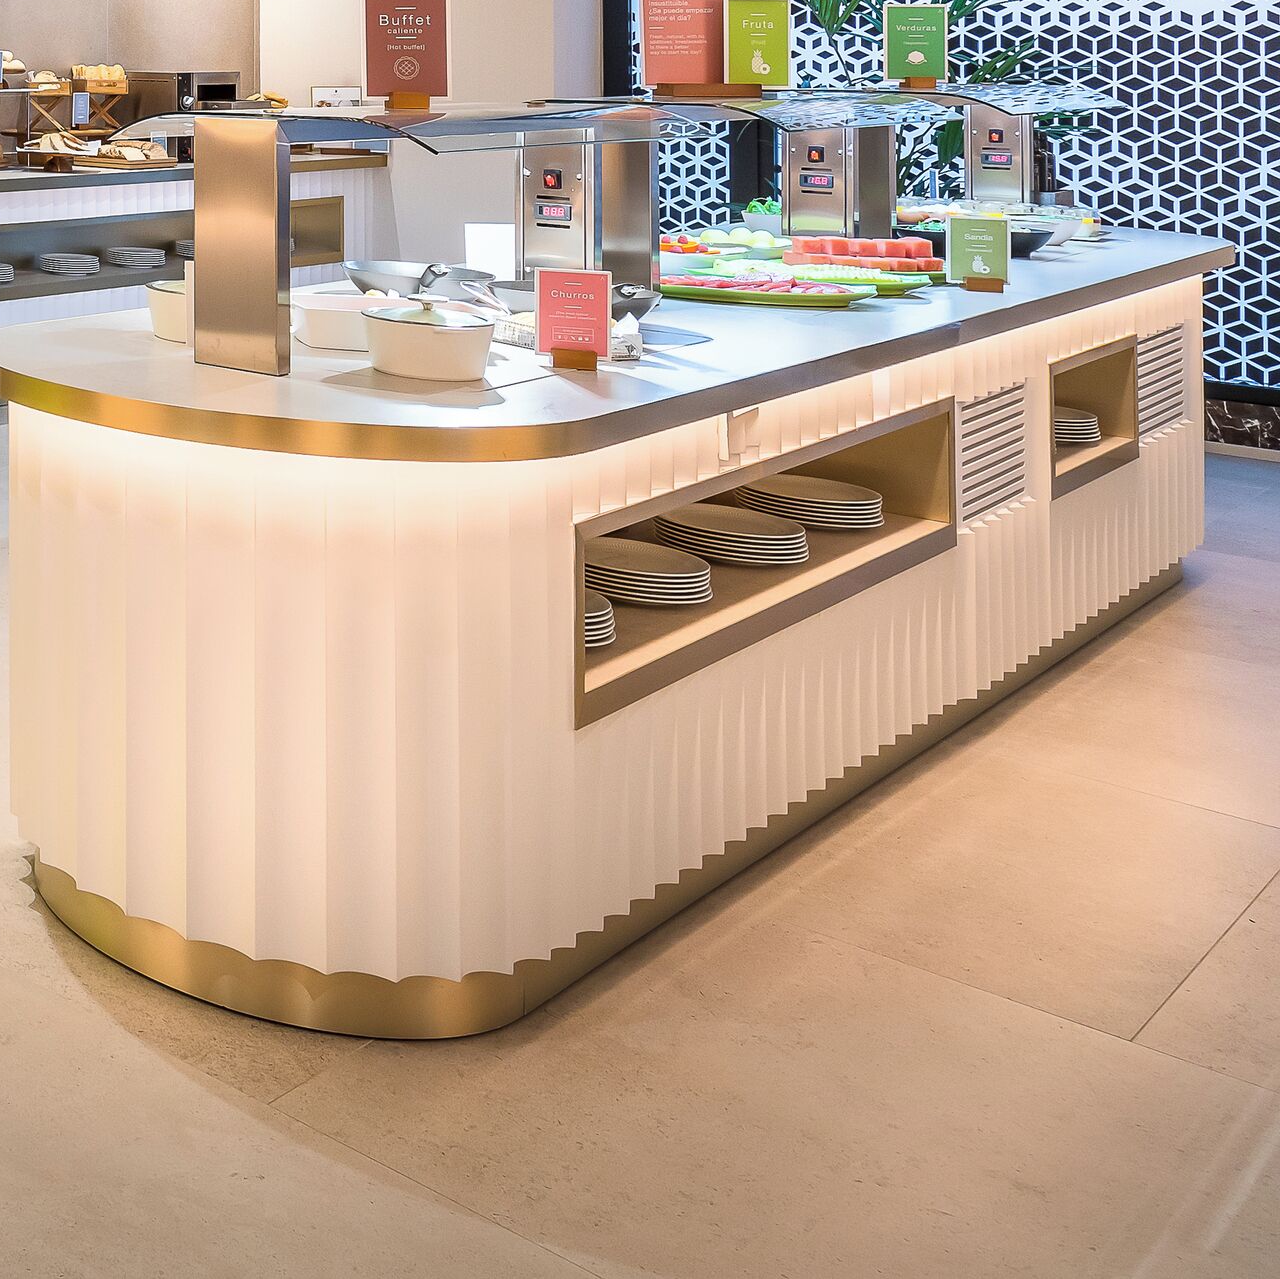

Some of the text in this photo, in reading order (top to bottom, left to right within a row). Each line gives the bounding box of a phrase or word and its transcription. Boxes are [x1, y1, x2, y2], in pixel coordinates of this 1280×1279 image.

[379, 14, 431, 26] Buffet
[742, 19, 774, 29] Fruta
[895, 24, 937, 32] Verduras
[550, 289, 595, 300] Churros
